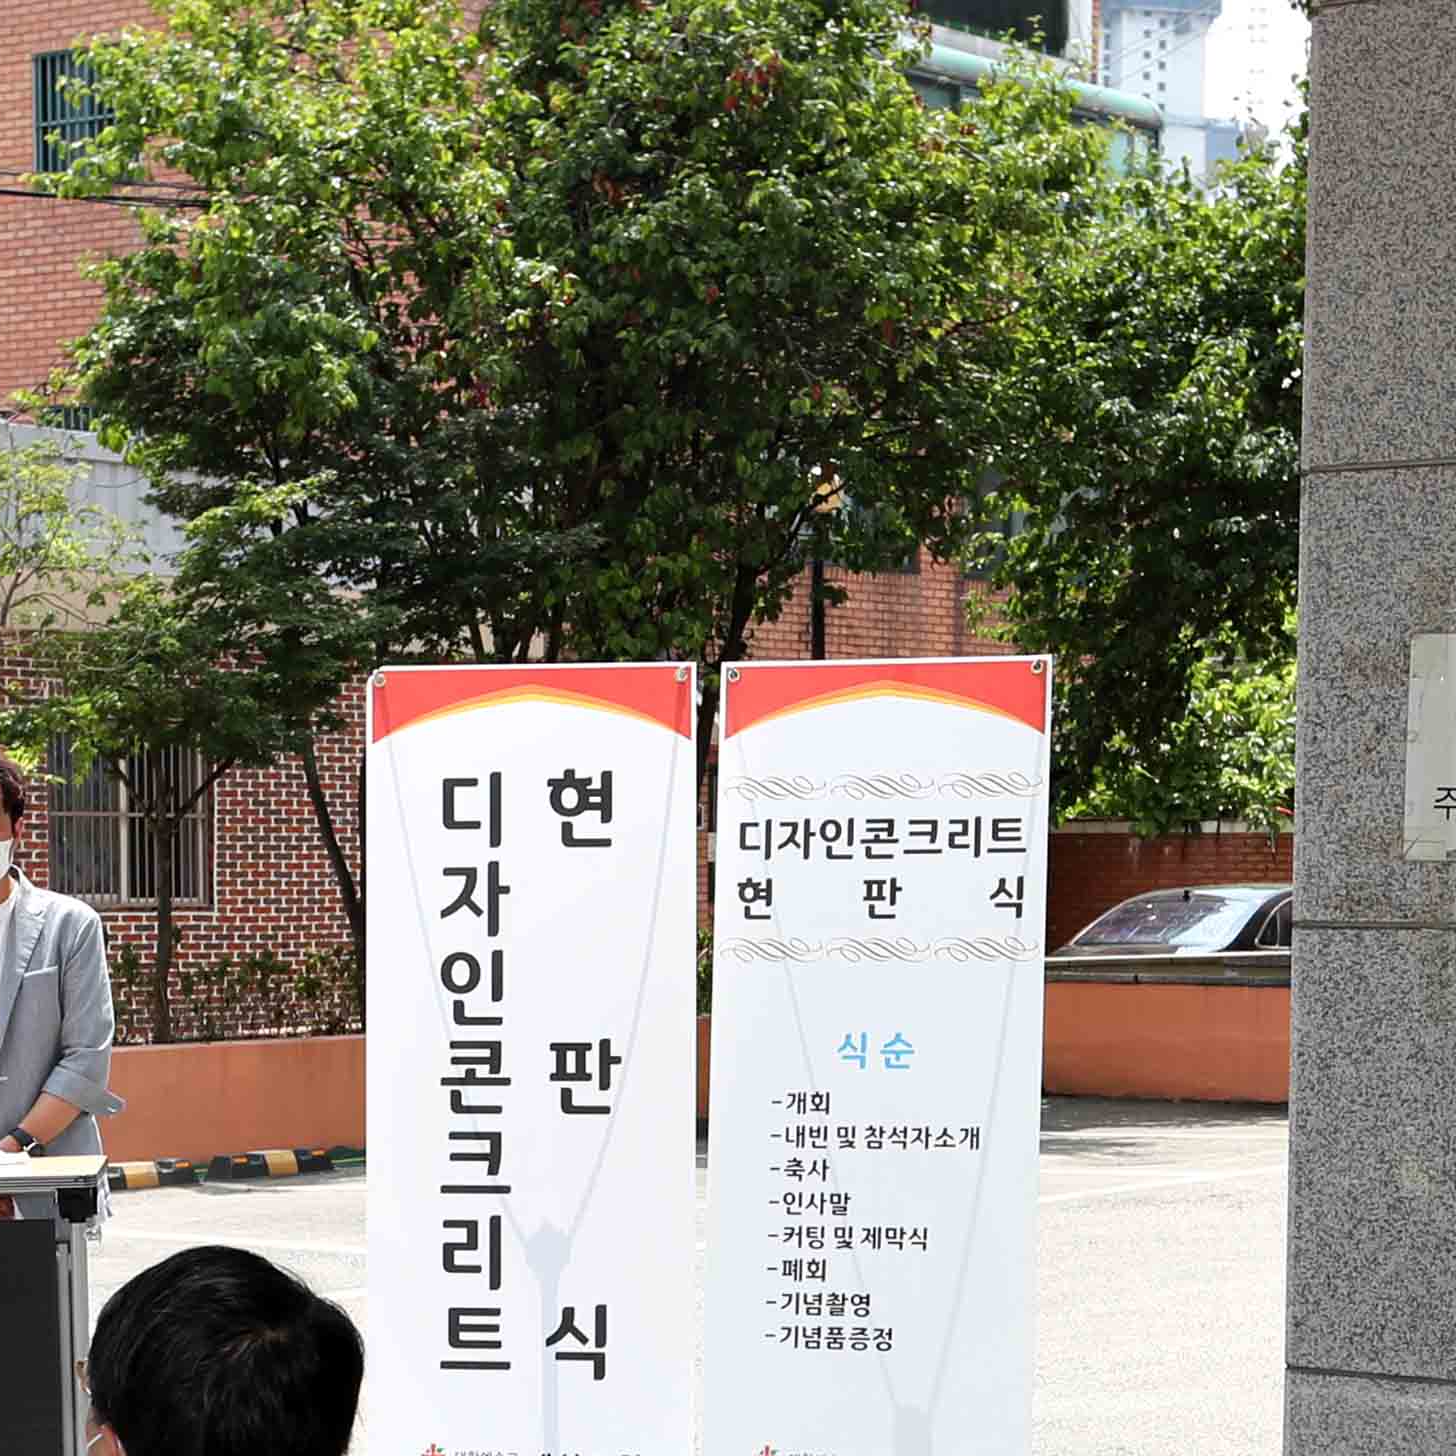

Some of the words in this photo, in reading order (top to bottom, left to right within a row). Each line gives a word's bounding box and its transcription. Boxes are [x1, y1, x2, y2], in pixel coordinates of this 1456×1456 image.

[738, 815, 1028, 862] 디자인콘크리트
[836, 1031, 916, 1070] 식순
[439, 770, 513, 1371] 디자인콘크리트
[836, 1124, 857, 1150] 및
[863, 1124, 981, 1151] 참석자소개
[833, 1225, 855, 1251] 및
[859, 1225, 929, 1253] 제막식
